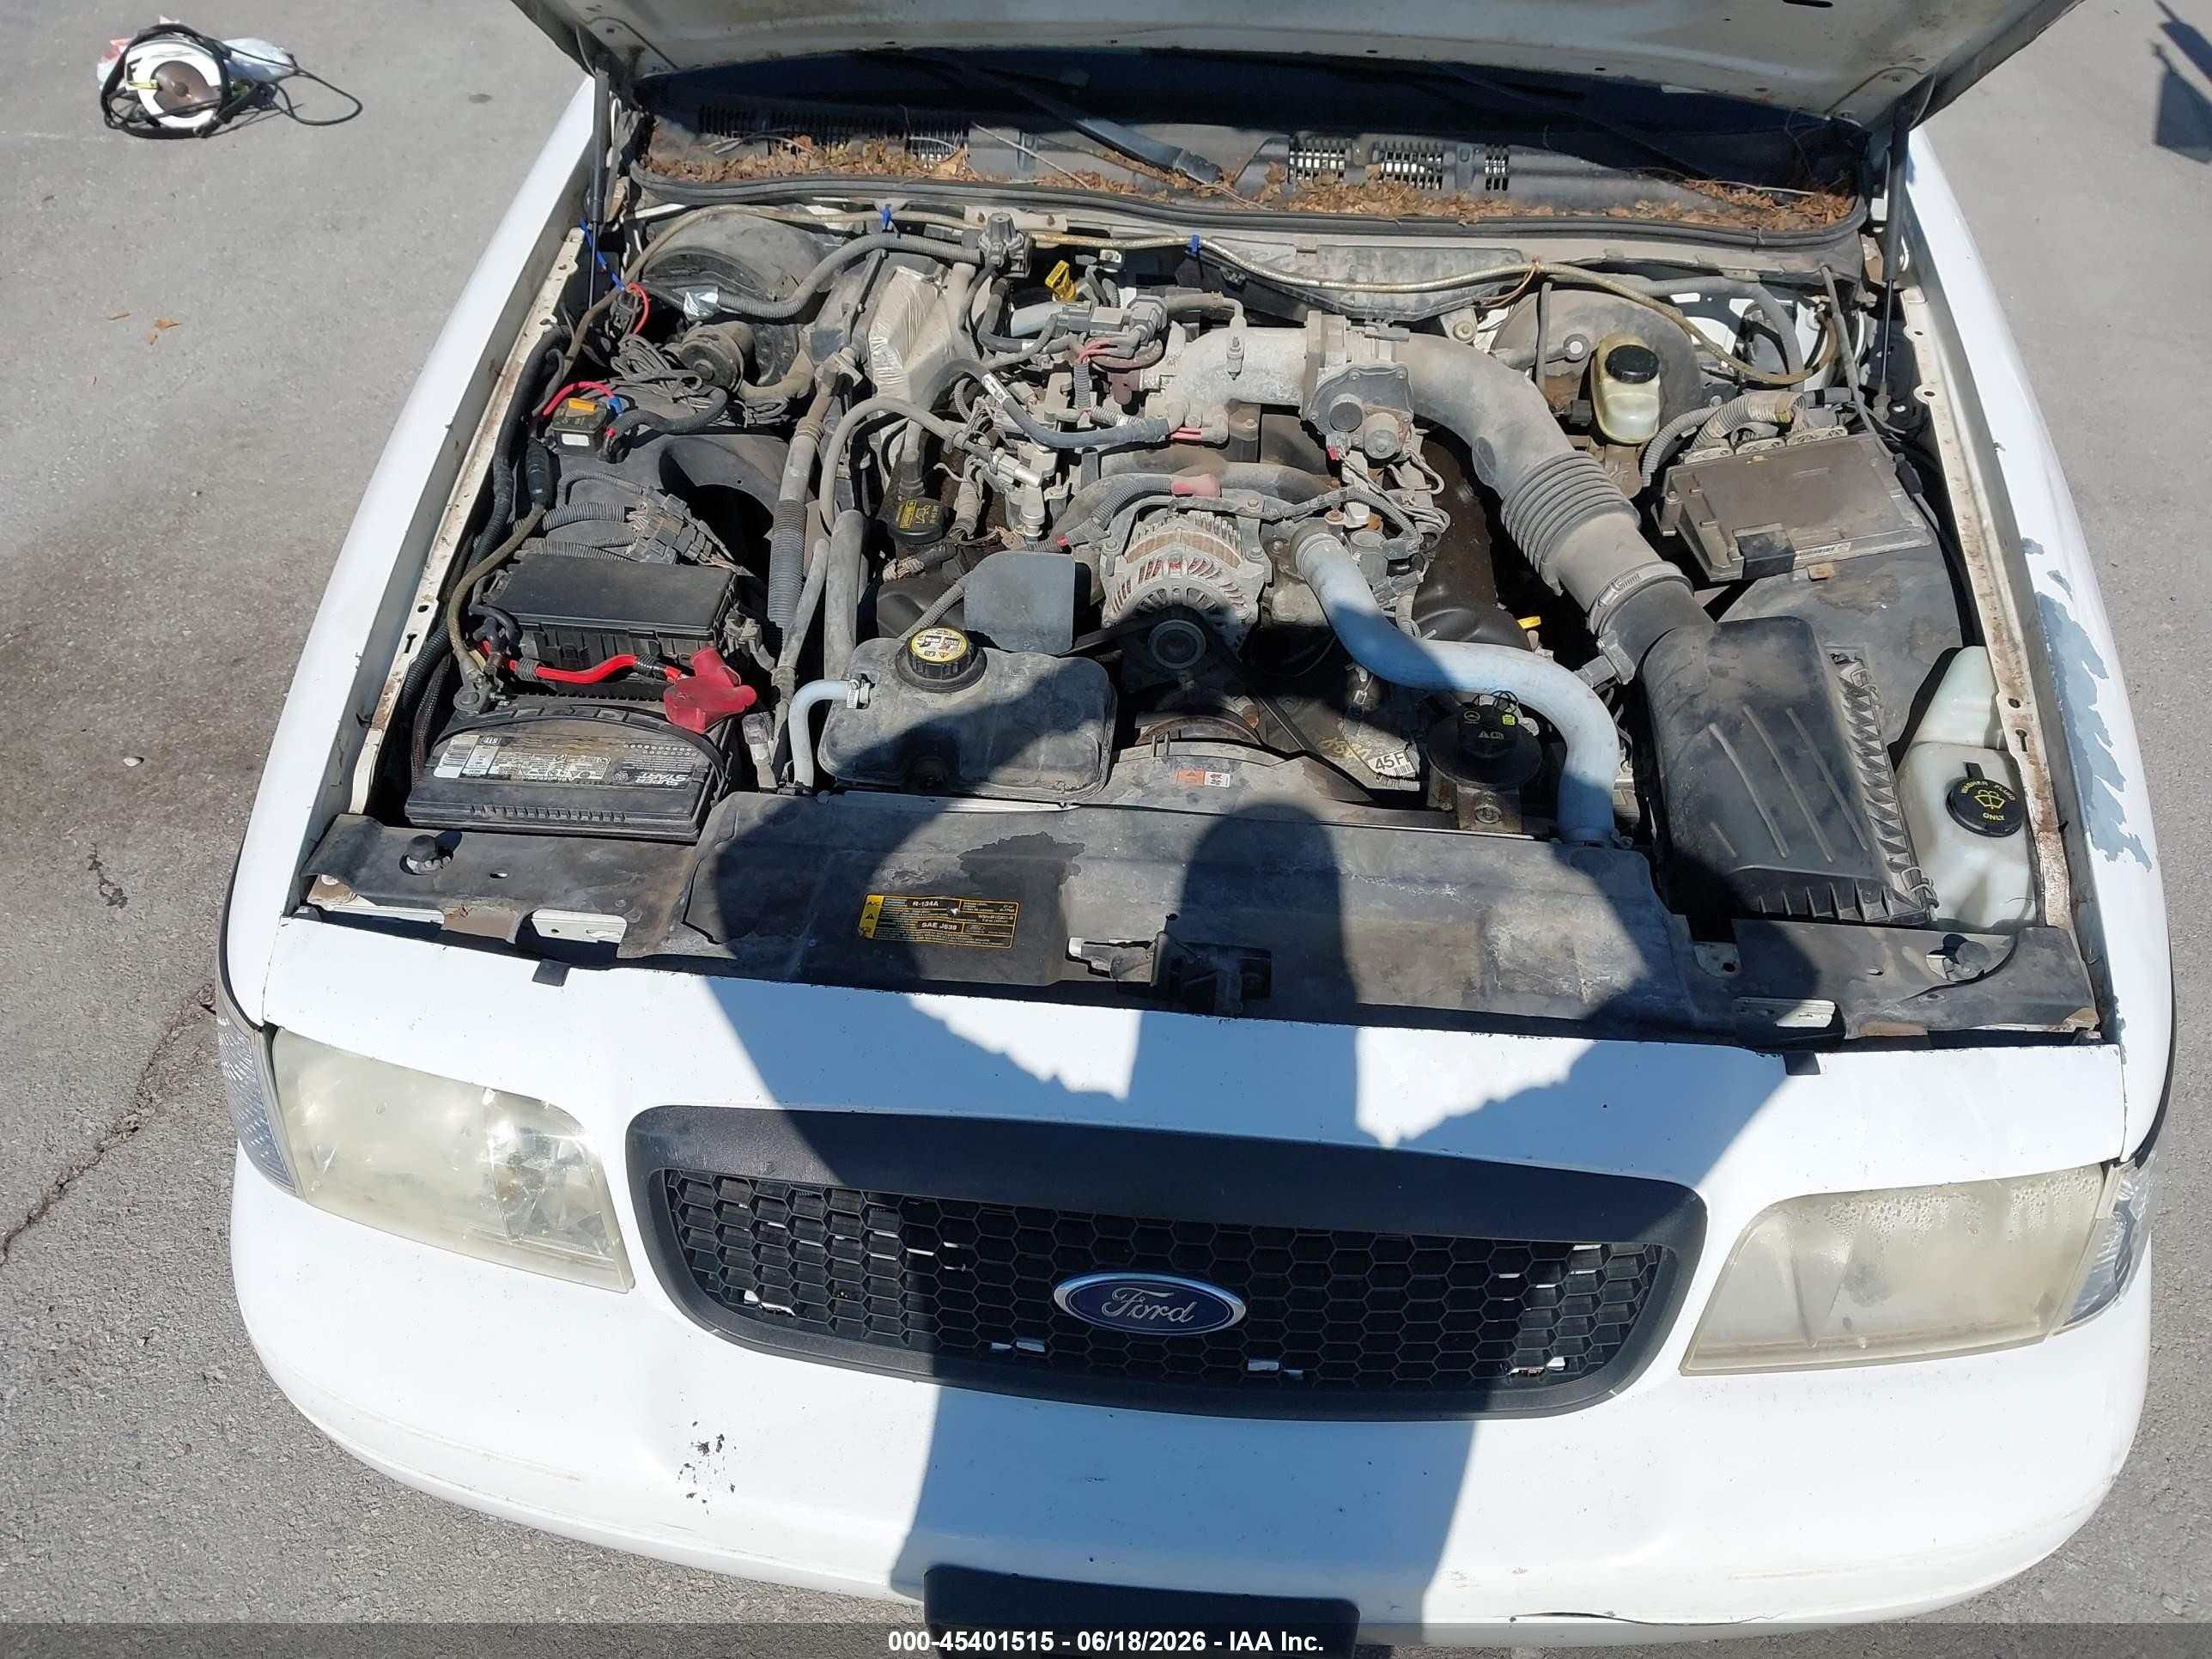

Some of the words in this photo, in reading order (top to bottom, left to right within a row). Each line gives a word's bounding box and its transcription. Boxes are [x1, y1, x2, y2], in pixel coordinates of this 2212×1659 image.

[635, 772, 690, 782] START
[635, 777, 679, 787] SUPER
[1960, 781, 1989, 793] WASHER
[1994, 784, 2016, 800] FLUID
[1982, 812, 2005, 821] ONLY
[1101, 1287, 1198, 1323] Ford
